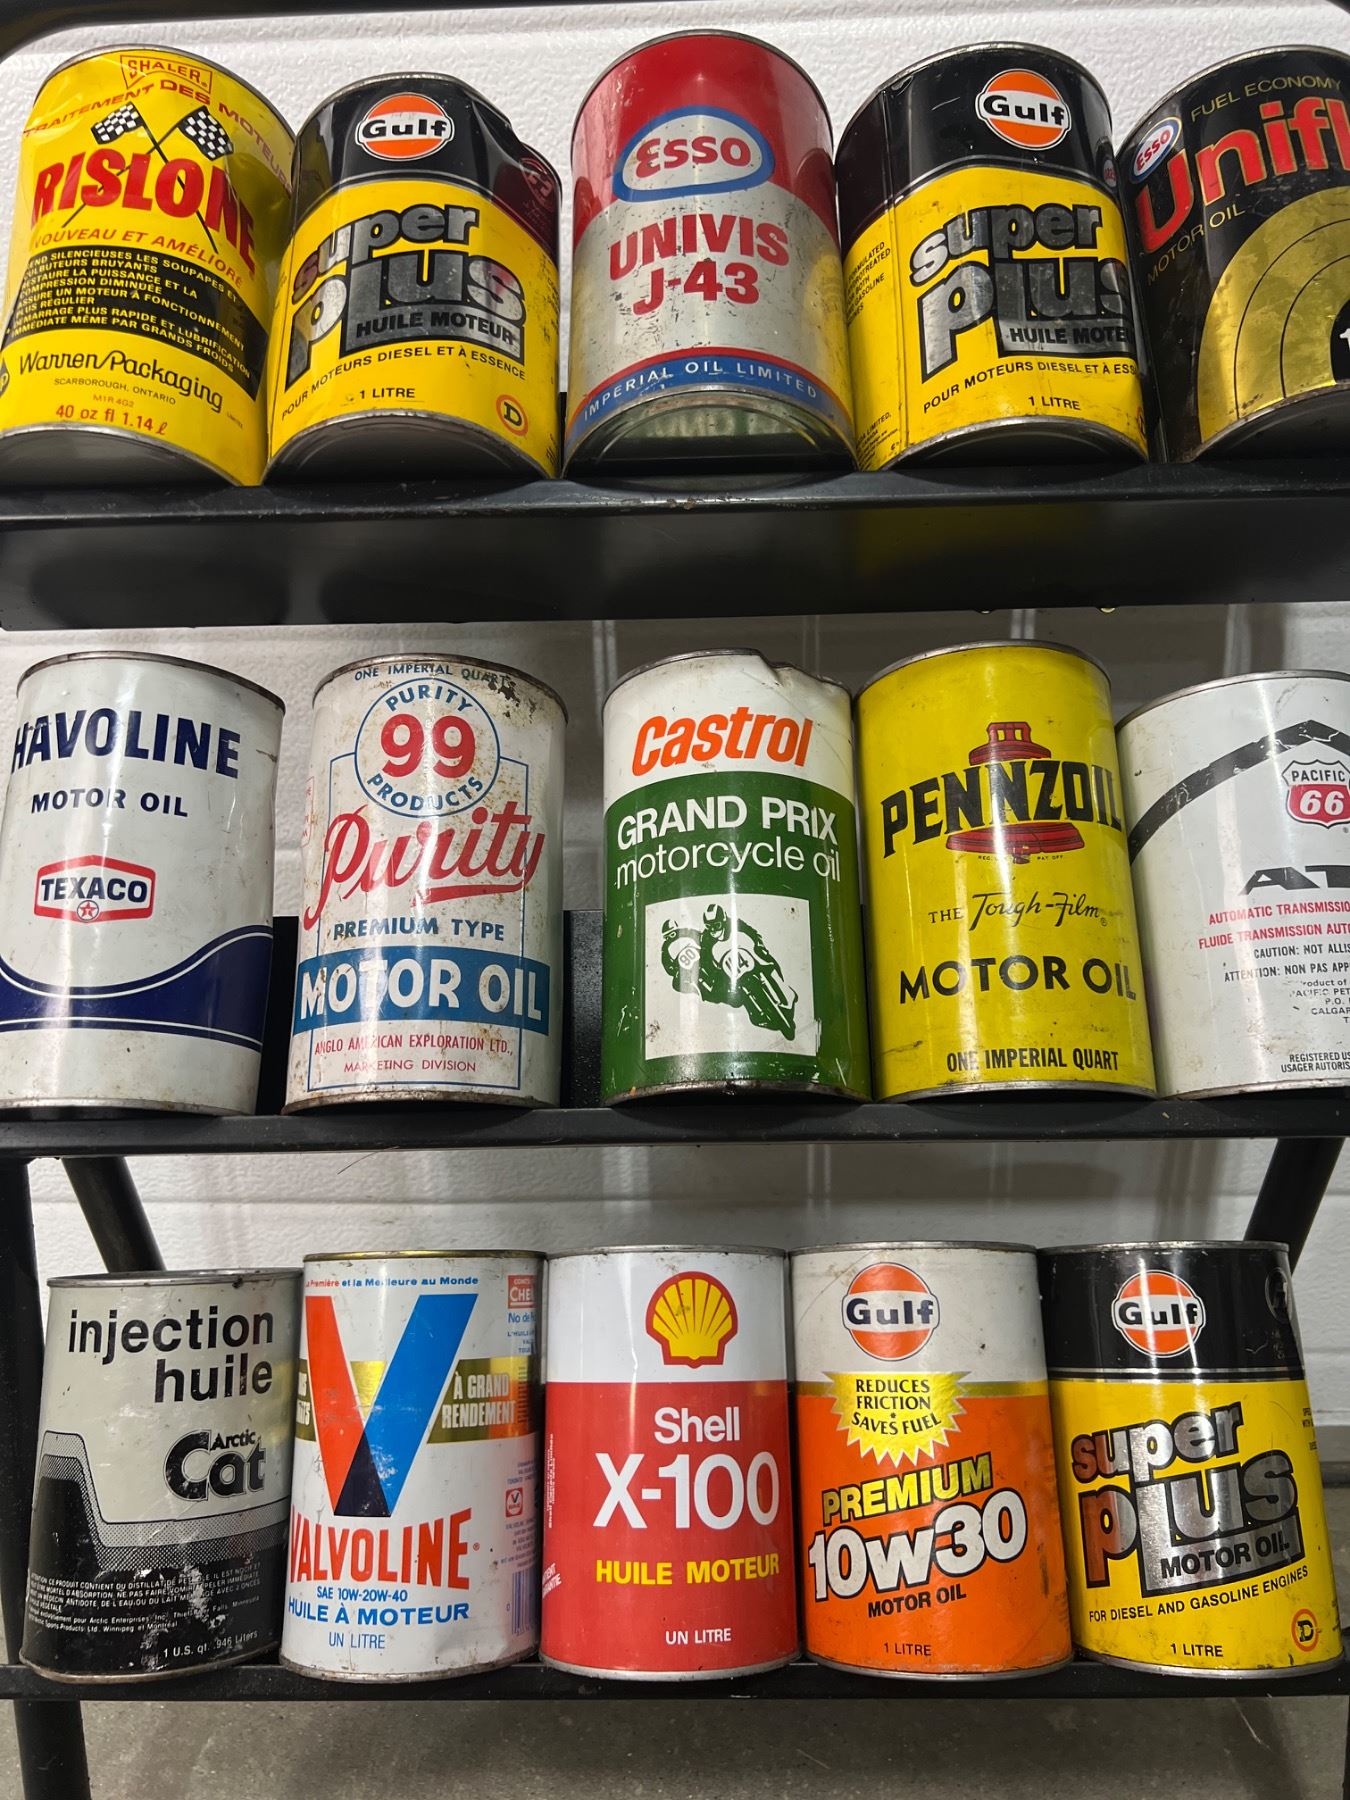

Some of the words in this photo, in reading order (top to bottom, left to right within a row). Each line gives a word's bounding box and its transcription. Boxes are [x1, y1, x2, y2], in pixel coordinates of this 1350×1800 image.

[23, 84, 154, 137] TRAITEMENT
[161, 80, 209, 104] DES
[983, 94, 1066, 125] Gulf
[1191, 92, 1240, 122] FUEL
[1245, 75, 1341, 96] ECONOMY
[362, 119, 448, 139] Gulf
[1136, 130, 1170, 170] ESSO
[31, 148, 256, 276] RISLONE
[35, 229, 116, 249] NOUVEAU
[123, 231, 148, 243] ET
[292, 203, 479, 305] super
[609, 213, 789, 280] UNIVIS
[909, 203, 1103, 287] super
[1146, 225, 1204, 286] MOTOR
[1209, 203, 1245, 228] OIL
[51, 250, 132, 260] SILENCIEUSES
[137, 254, 158, 264] LES
[162, 259, 224, 292] SOUPAPES
[228, 288, 237, 302] ET
[92, 258, 158, 273] BRUYANTS
[91, 268, 161, 285] PUISSANCE
[165, 280, 180, 290] ET
[183, 286, 198, 299] LA
[633, 259, 760, 315] J-43
[56, 288, 71, 296] UN
[76, 288, 127, 297] MOTEUR
[144, 294, 244, 351] FONCTIONNEMENT
[285, 248, 526, 393] plus
[356, 312, 424, 337] HUILE
[431, 312, 516, 344] MOTEUR
[77, 307, 107, 315] PLUS
[112, 308, 157, 324] RAPIDE
[161, 320, 175, 330] ET
[179, 327, 251, 378] LUBRIFICATION
[112, 318, 137, 329] PAR
[142, 323, 192, 348] GRANDS
[196, 344, 234, 372] FROIDS
[1010, 327, 1068, 344] HUILE
[133, 386, 176, 405] ONTARIO
[282, 390, 308, 420] POUR
[312, 355, 371, 392] MOTEURS
[378, 347, 432, 362] DIESEL
[436, 346, 452, 356] ET
[471, 351, 525, 380] ESSENCE
[360, 391, 365, 399] 1
[372, 388, 416, 398] LITRE
[585, 367, 674, 421] IMPERIAL
[685, 362, 723, 374] OIL
[736, 362, 817, 399] LIMITED
[924, 384, 960, 414] POUR
[964, 361, 1033, 387] MOTEURS
[1038, 361, 1082, 373] DIESEL
[1085, 364, 1099, 373] ET
[56, 405, 73, 418] 40
[80, 409, 96, 420] oz
[123, 413, 152, 430] 1.14
[504, 402, 522, 427] D
[1028, 397, 1035, 406] 1
[1042, 397, 1080, 410] LITRE
[355, 668, 378, 681] ONE
[387, 663, 453, 675] IMPERIAL
[385, 685, 472, 711] PURITY
[11, 708, 241, 778] HAVOLINE
[381, 714, 475, 778] 99
[632, 707, 813, 776] Castrol
[1292, 769, 1346, 782] PACIFIC
[32, 788, 125, 814] MOTOR
[140, 792, 189, 816] OIL
[367, 774, 483, 810] PRODUCTS
[1300, 790, 1344, 815] 66
[617, 796, 747, 850] GRAND
[762, 796, 838, 845] PRIX
[881, 760, 1122, 859] PENNZOIL
[304, 801, 545, 930] Purity
[617, 836, 804, 889] motorcycle
[813, 852, 840, 882] oil
[41, 877, 148, 902] TEXACO
[928, 908, 964, 924] THE
[969, 892, 1099, 931] Tough-Film
[1209, 906, 1272, 925] AUTOMATIC
[334, 918, 438, 940] PREMIUM
[452, 919, 505, 940] TYPE
[1199, 934, 1233, 949] FLUIDE
[1238, 924, 1322, 942] TRANSMISSION
[1254, 947, 1300, 959] CAUTION:
[1304, 944, 1323, 954] NOT
[900, 955, 1069, 1004] MOTOR
[1083, 958, 1136, 1000] OIL
[1285, 966, 1306, 975] NON
[1310, 963, 1327, 973] PAS
[301, 959, 462, 1020] MOTOR
[479, 964, 542, 1020] OIL
[315, 1039, 343, 1055] ANGLO
[410, 1035, 483, 1051] EXPLORATION
[947, 1052, 979, 1072] ONE
[986, 1048, 1067, 1068] IMPERIAL
[1072, 1048, 1119, 1070] QUART
[1290, 1052, 1339, 1062] REGISTERED
[422, 1059, 476, 1072] DIVISION
[1281, 1063, 1314, 1072] USAGER
[353, 1279, 362, 1287] la
[440, 1277, 478, 1285] Monde
[847, 1298, 933, 1325] Gulf
[1118, 1302, 1199, 1325] Gulf
[69, 1306, 273, 1365] injection
[155, 1353, 273, 1403] huile
[453, 1372, 462, 1399] À
[468, 1374, 509, 1399] GRAND
[856, 1379, 930, 1393] REDUCES
[442, 1401, 516, 1429] RENDEMENT
[856, 1396, 931, 1410] FRICTION
[654, 1406, 740, 1444] Shell
[852, 1411, 898, 1435] SAVES
[903, 1413, 941, 1434] FUEL
[212, 1429, 256, 1451] Arctic
[1071, 1401, 1243, 1484] super
[163, 1430, 266, 1501] Cat
[593, 1452, 780, 1530] X-100
[822, 1452, 993, 1526] PREMIUM
[1079, 1450, 1302, 1592] plus
[290, 1506, 471, 1590] VALVOLINE
[1161, 1541, 1251, 1579] MOTOR
[1256, 1532, 1290, 1558] OIL
[596, 1560, 672, 1585] HUILE
[687, 1553, 779, 1584] MOTEUR
[80, 1582, 113, 1590] CONTIENT
[317, 1586, 333, 1599] SAE
[338, 1588, 408, 1602] 10W-20W-40
[868, 1591, 930, 1618] MOTOR
[936, 1584, 966, 1603] OIL
[1089, 1610, 1107, 1622] FOR
[1111, 1605, 1153, 1621] DIESEL
[1158, 1601, 1185, 1616] AND
[1193, 1585, 1259, 1610] GASOLINE
[1263, 1565, 1308, 1593] ENGINES
[289, 1597, 329, 1622] HUILE
[336, 1603, 349, 1624] À
[358, 1603, 469, 1626] MOTEUR
[329, 1632, 344, 1647] UN
[351, 1632, 385, 1649] LITRE
[666, 1631, 688, 1645] UN
[695, 1628, 731, 1644] LITRE
[1298, 1620, 1314, 1642] D
[164, 1649, 168, 1658] 1
[173, 1645, 193, 1657] U.S.
[883, 1642, 889, 1654] 1
[895, 1643, 932, 1656] LITRE
[1171, 1643, 1178, 1655] 1
[1183, 1643, 1223, 1657] LITRE
